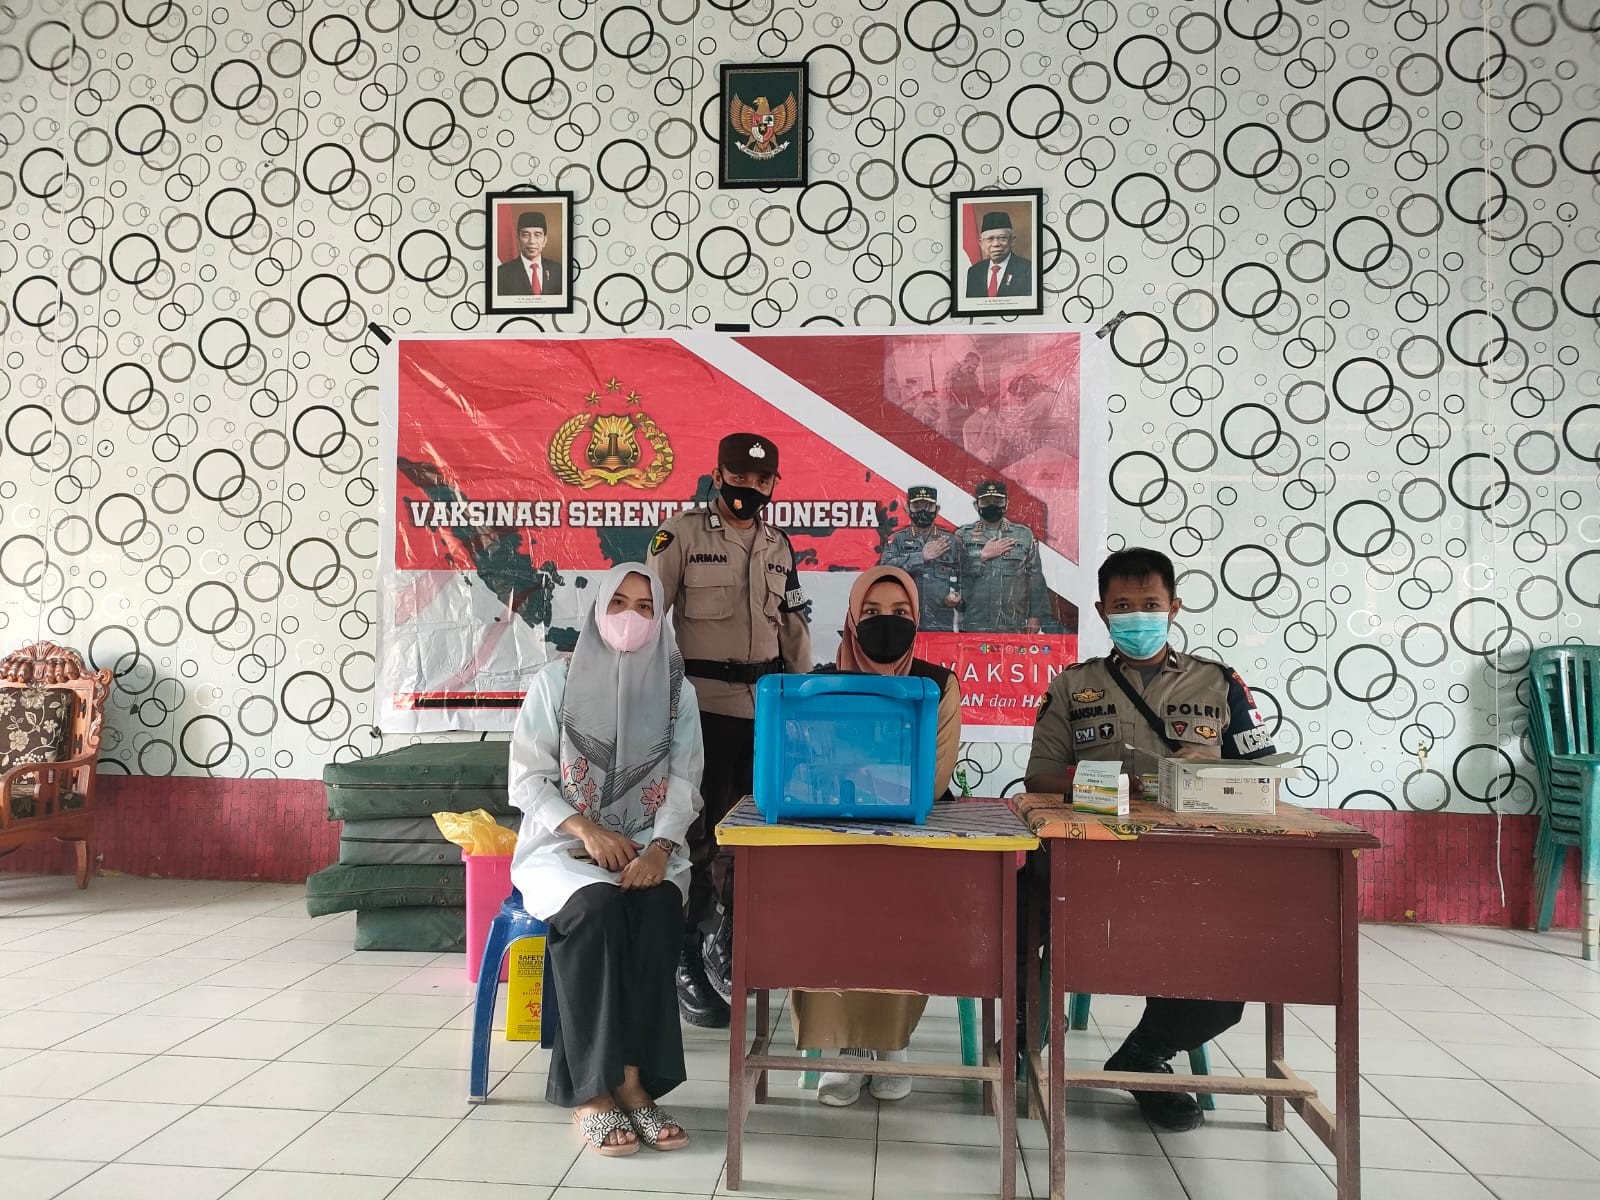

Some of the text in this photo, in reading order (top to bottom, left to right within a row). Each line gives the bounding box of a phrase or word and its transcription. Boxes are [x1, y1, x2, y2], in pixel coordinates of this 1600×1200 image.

[410, 501, 561, 527] VAKSINASI
[568, 501, 708, 527] SERENT
[688, 553, 728, 564] ARMAN
[989, 694, 1017, 708] dan
[1166, 703, 1220, 719] POLRI
